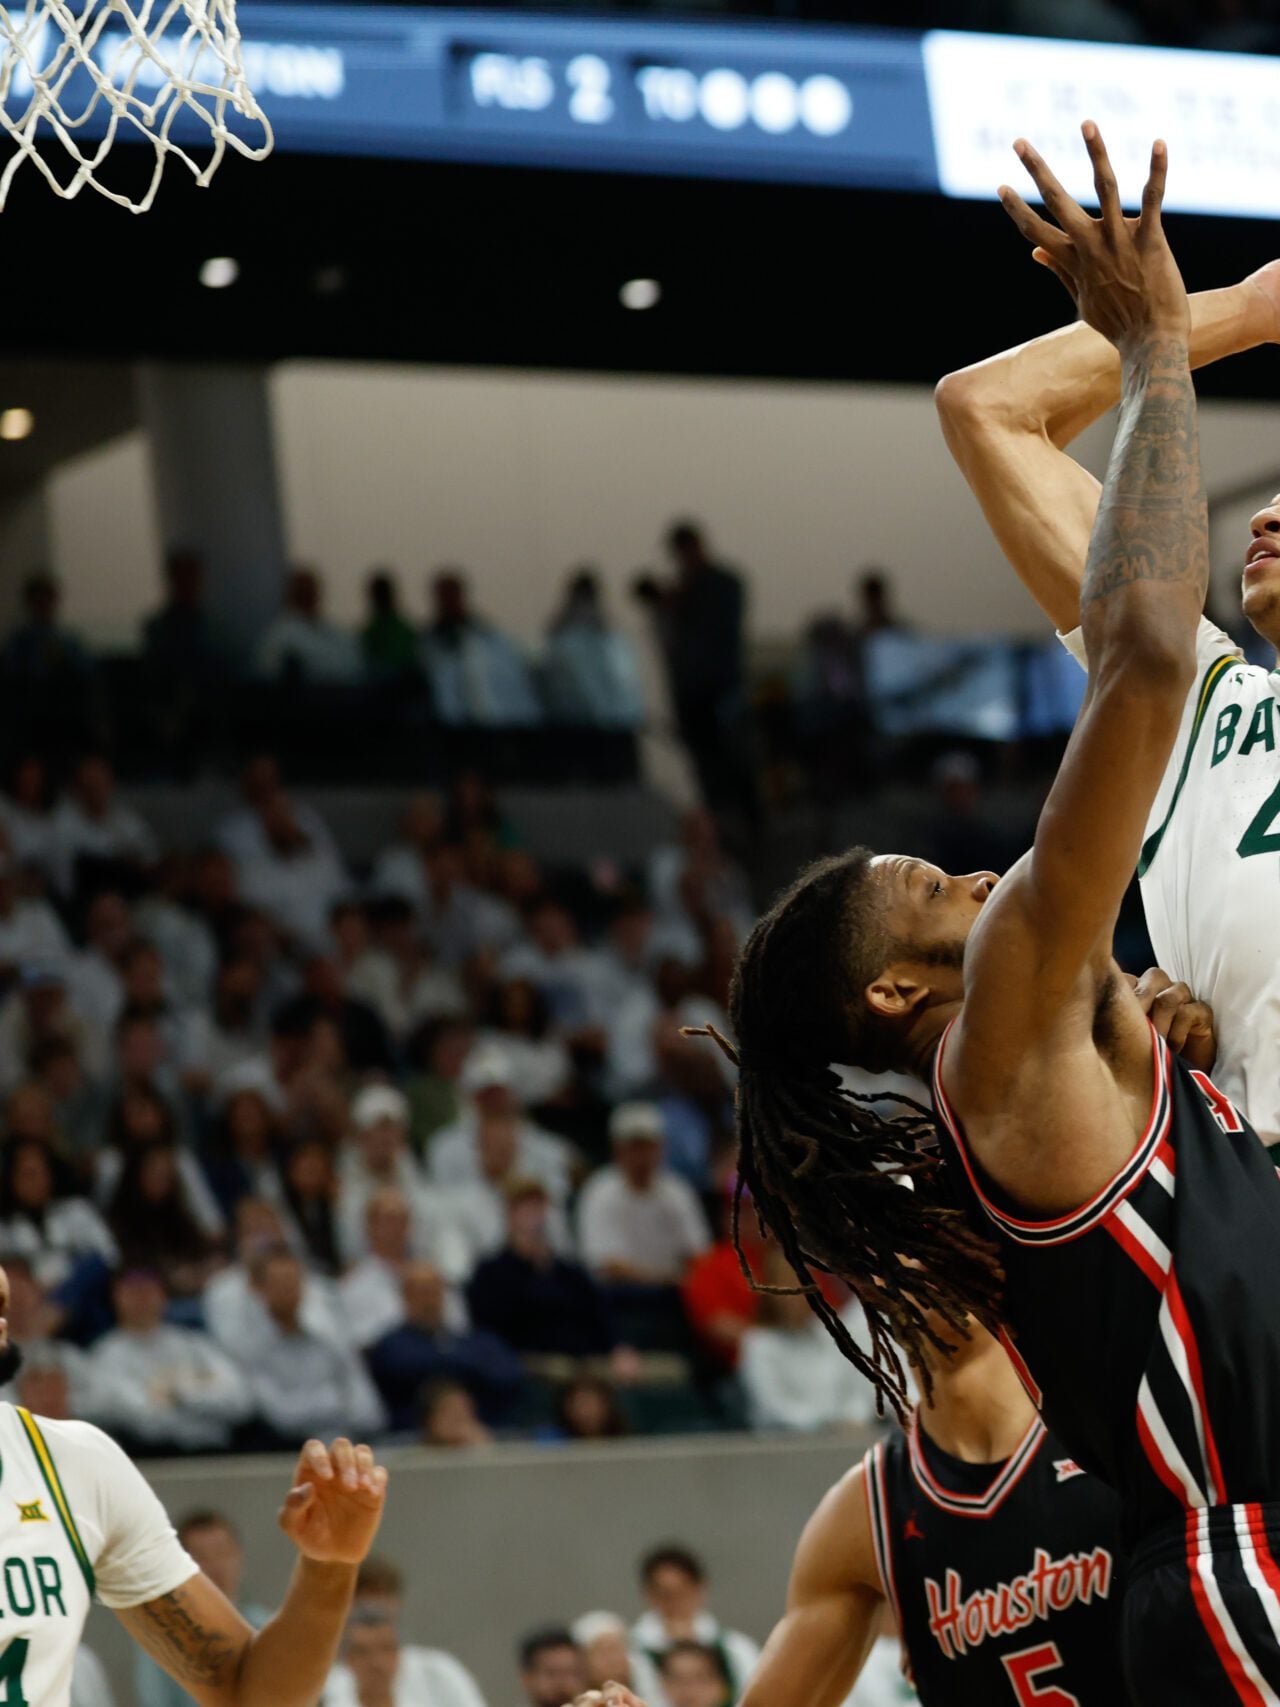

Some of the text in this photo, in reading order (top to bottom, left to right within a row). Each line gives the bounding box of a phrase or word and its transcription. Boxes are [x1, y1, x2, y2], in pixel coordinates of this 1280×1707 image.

[566, 52, 614, 124] 2
[0, 1557, 68, 1618] OR
[923, 1546, 1113, 1661] Houston
[1000, 1641, 1082, 1707] 5
